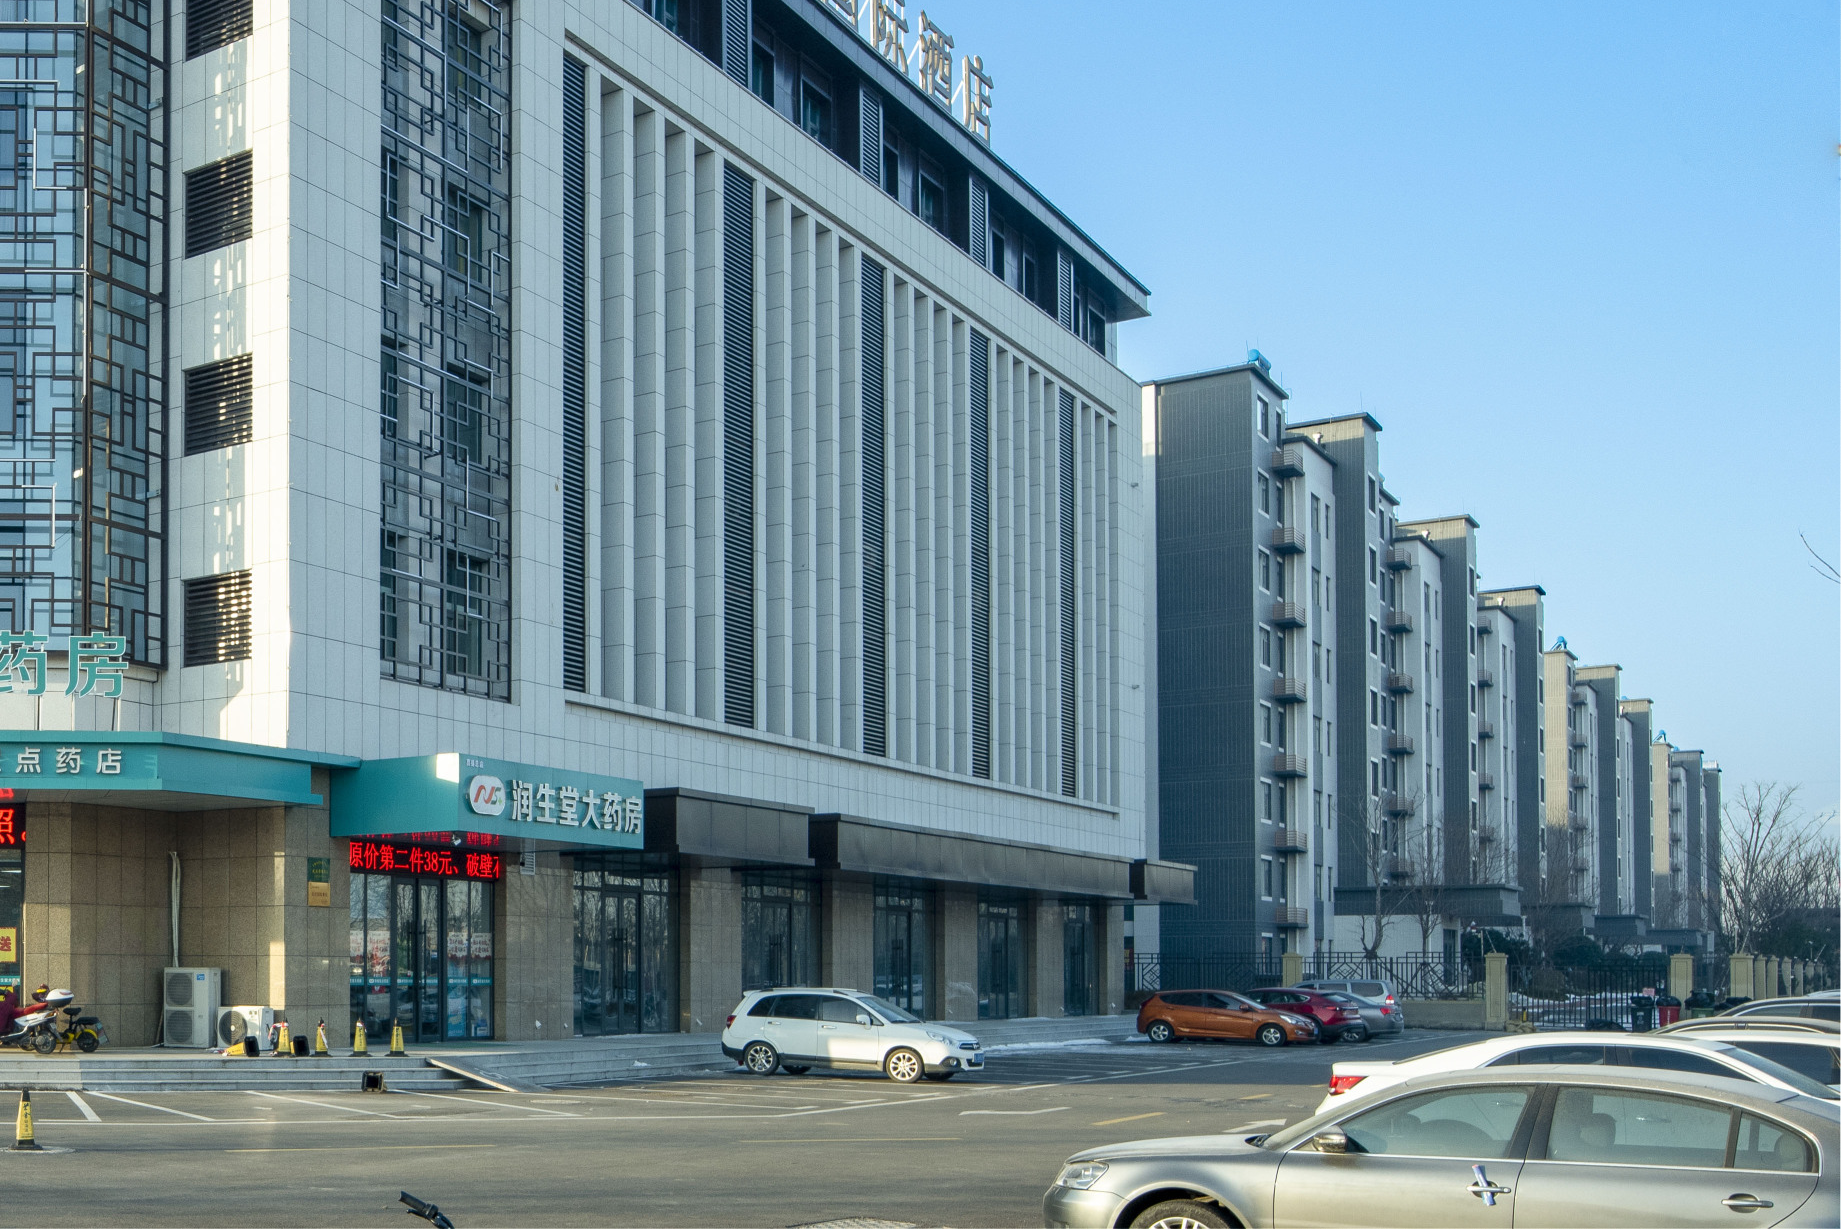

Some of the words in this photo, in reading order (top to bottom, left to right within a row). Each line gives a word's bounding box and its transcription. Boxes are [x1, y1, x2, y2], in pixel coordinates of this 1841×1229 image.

[511, 778, 643, 835] 润生堂大药房
